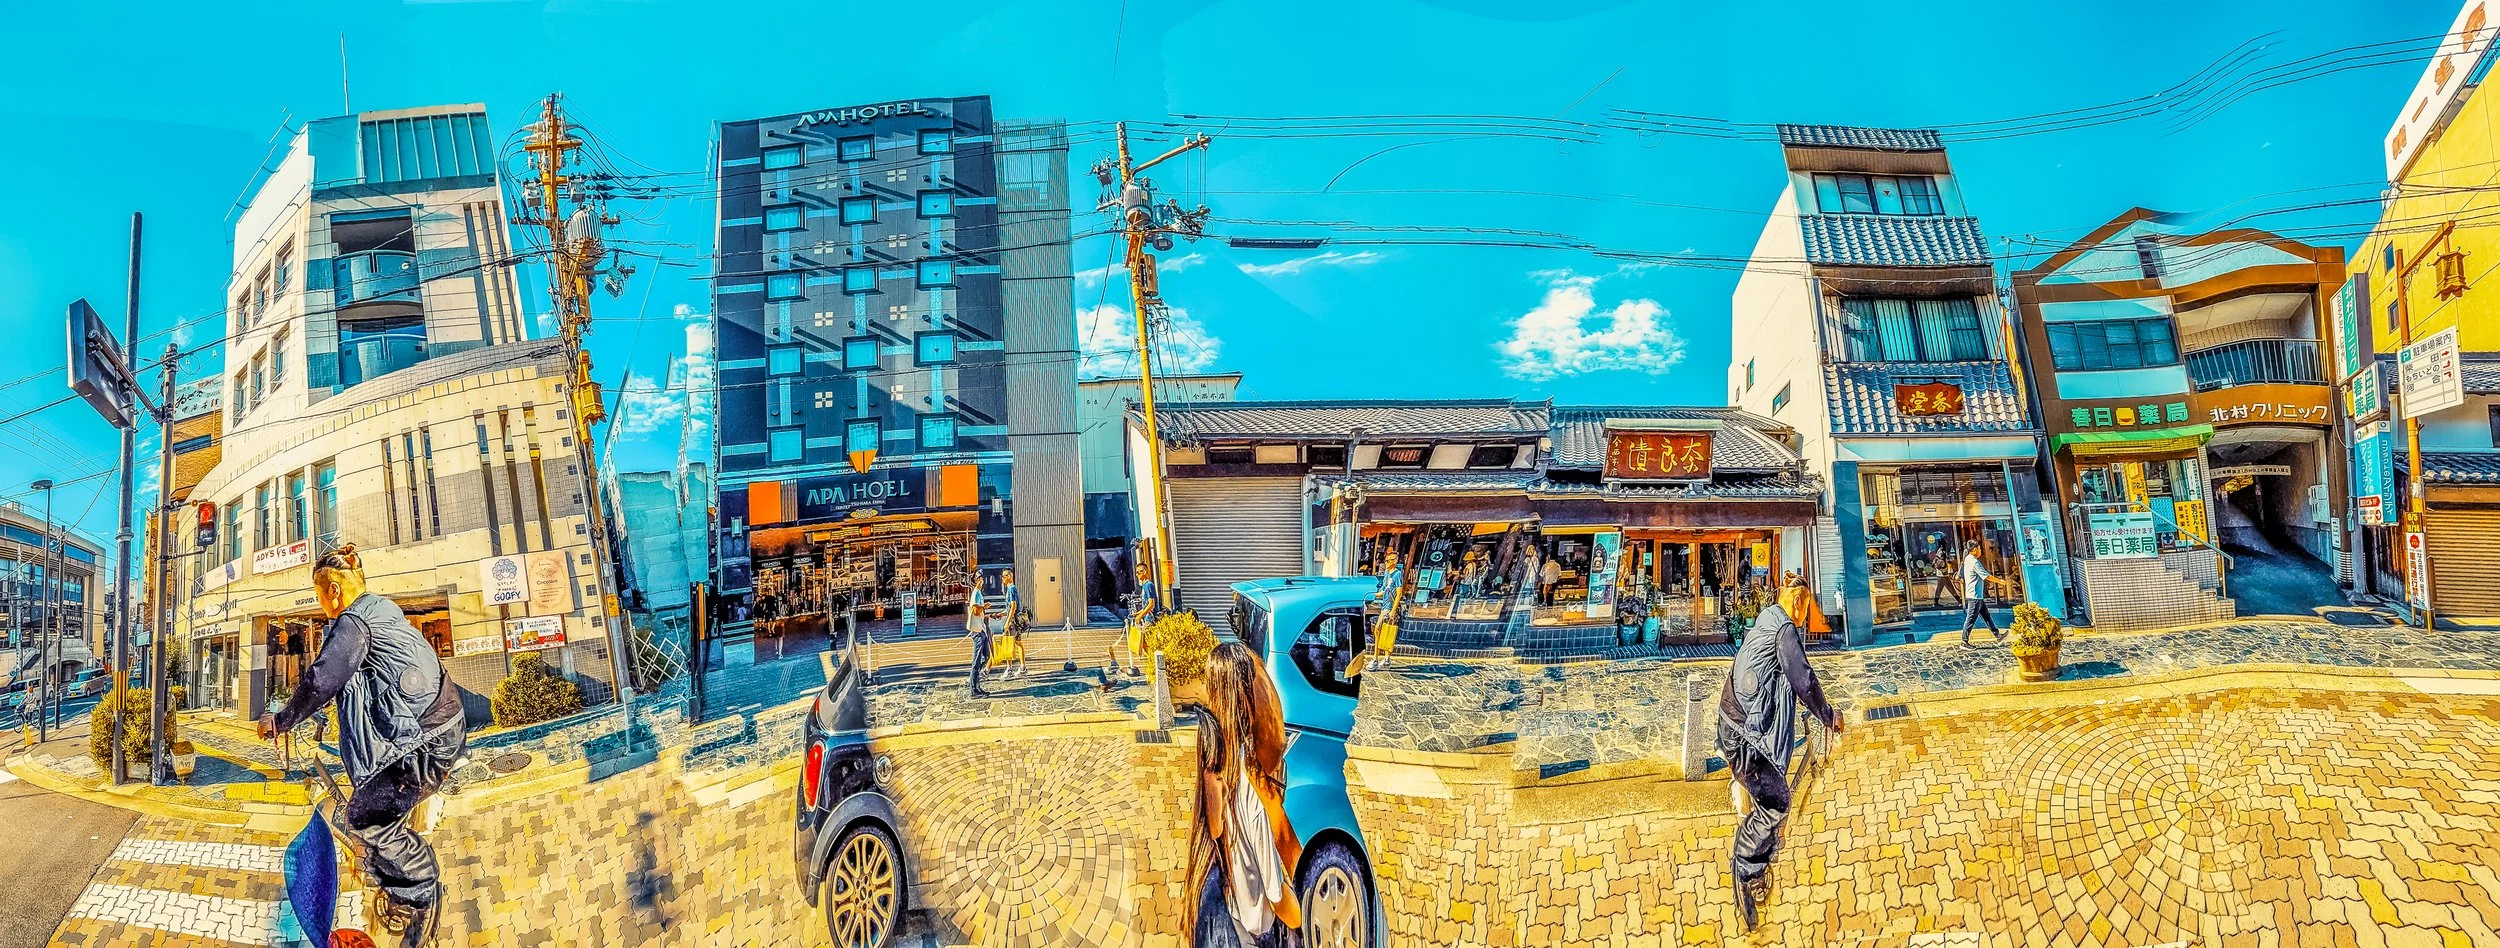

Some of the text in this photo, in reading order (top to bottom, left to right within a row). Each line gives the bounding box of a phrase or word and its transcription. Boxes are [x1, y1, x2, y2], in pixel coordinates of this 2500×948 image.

[796, 101, 926, 127] APA HOTEL
[2345, 284, 2358, 371] 北村クリニック
[2412, 333, 2452, 357] 駐車場案内
[2405, 364, 2441, 383] もちいどの
[2071, 401, 2189, 427] 春日 薬局
[2209, 402, 2328, 422] 北村クリニック
[806, 487, 846, 506] APA
[2093, 527, 2153, 537] 処方せん受け付けます
[2096, 537, 2156, 555] 春日薬局
